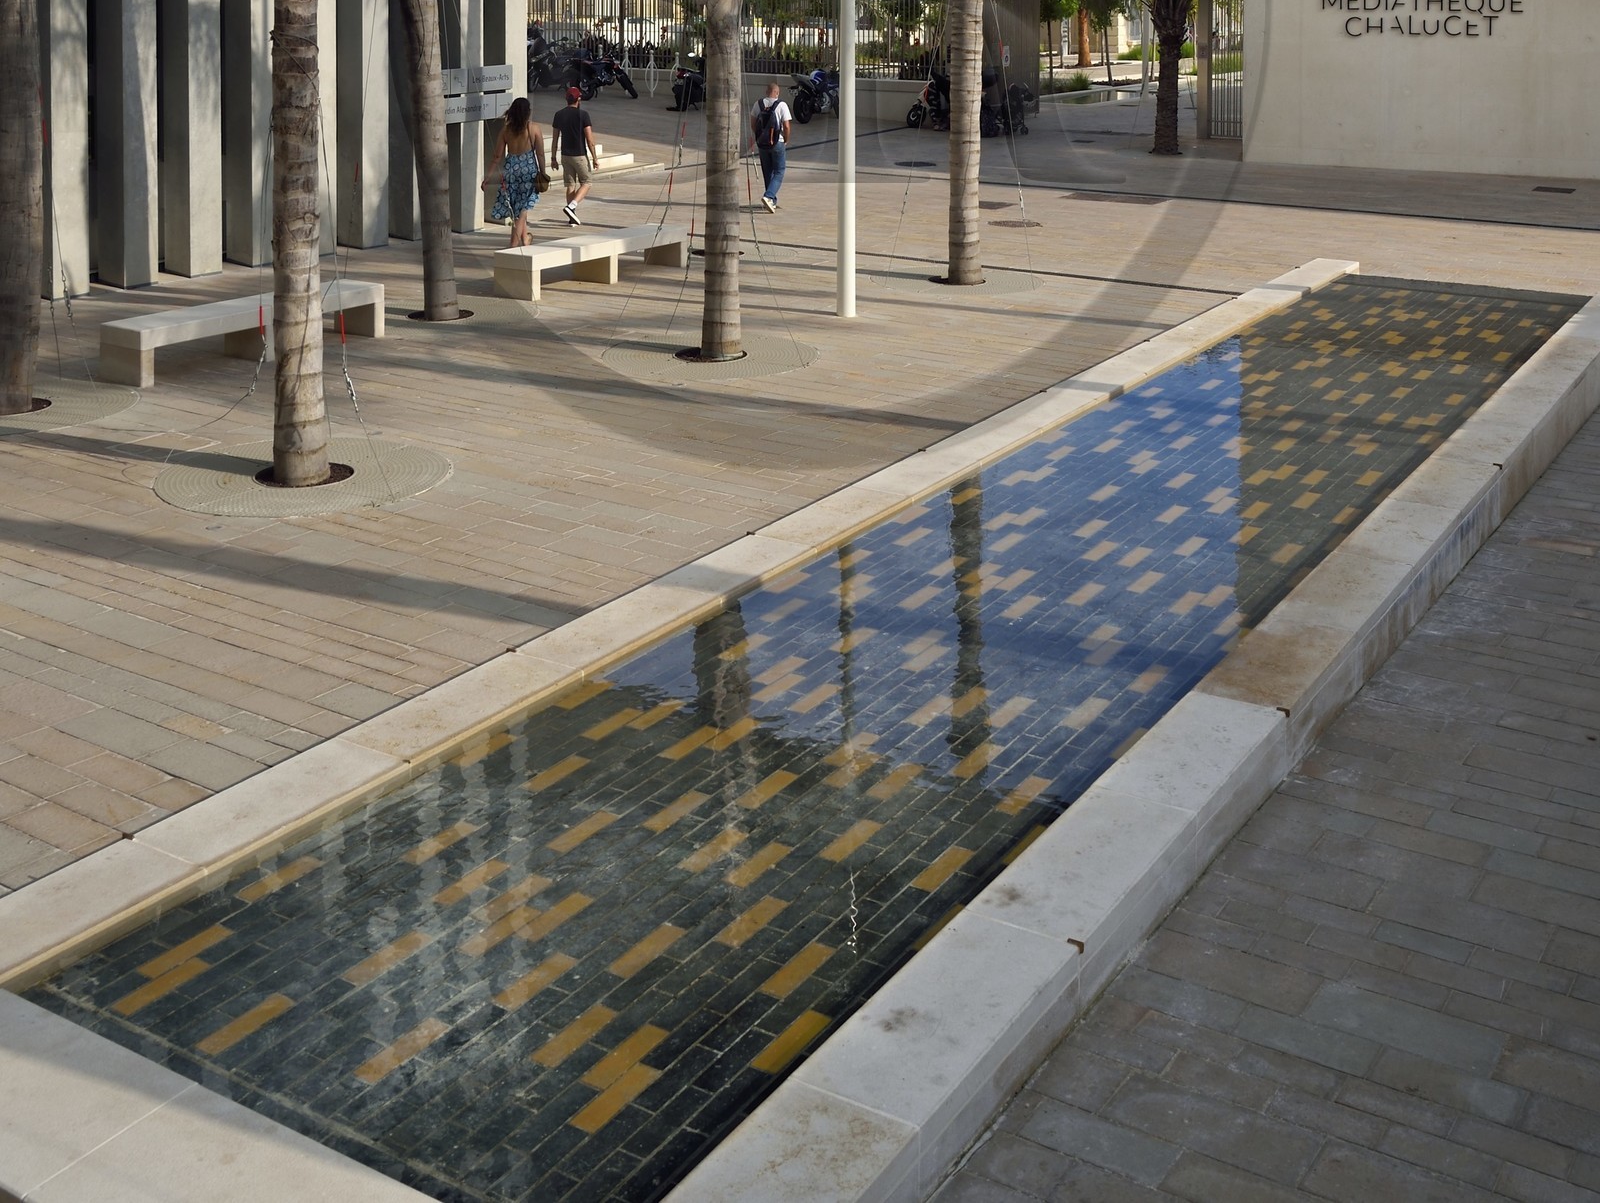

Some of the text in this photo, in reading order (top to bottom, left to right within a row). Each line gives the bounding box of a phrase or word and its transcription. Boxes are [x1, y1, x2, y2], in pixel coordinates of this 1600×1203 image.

[1344, 14, 1500, 38] CHALUCET
[472, 73, 510, 84] Les Beaux-Arts
[456, 103, 482, 114] Alexandre
